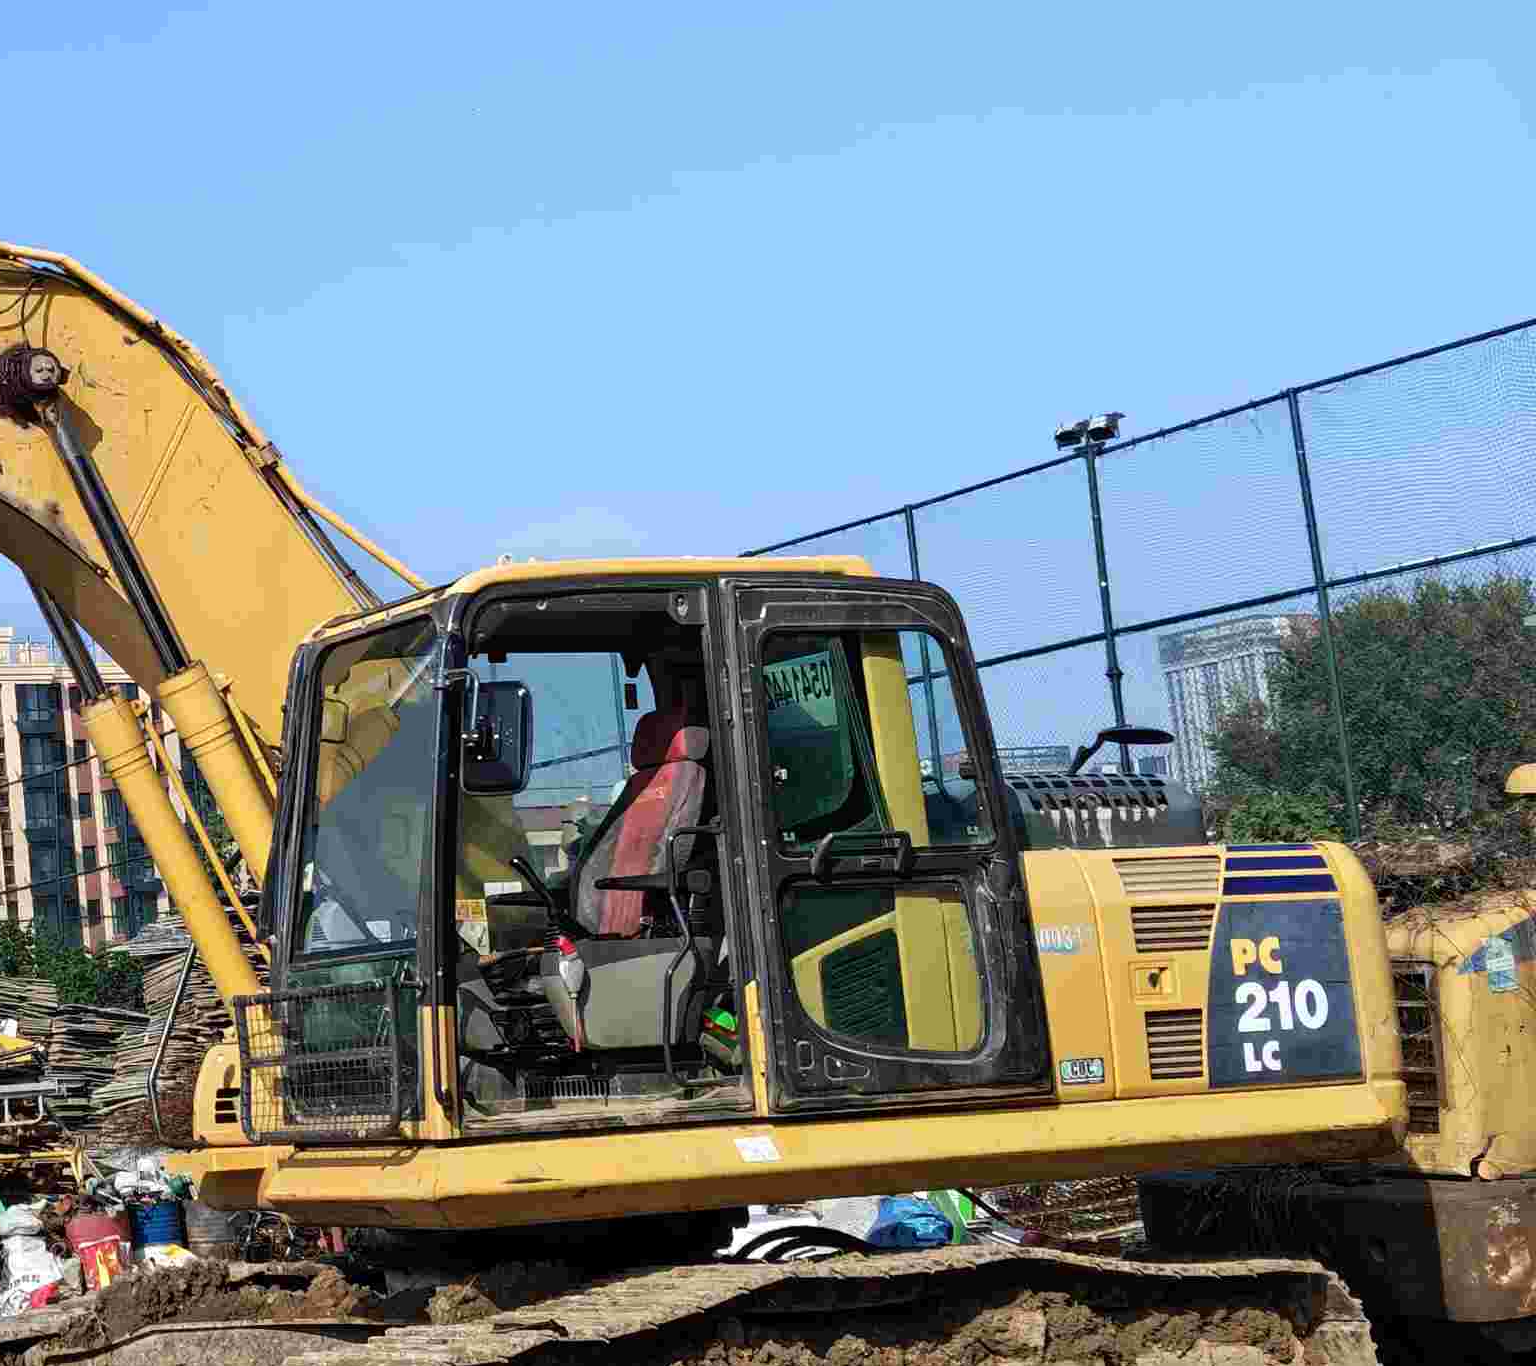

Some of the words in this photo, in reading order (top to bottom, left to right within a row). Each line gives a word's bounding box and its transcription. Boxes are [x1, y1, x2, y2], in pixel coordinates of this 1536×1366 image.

[1230, 936, 1283, 976] PC
[1235, 978, 1329, 1033] 210
[1242, 1039, 1283, 1073] LC
